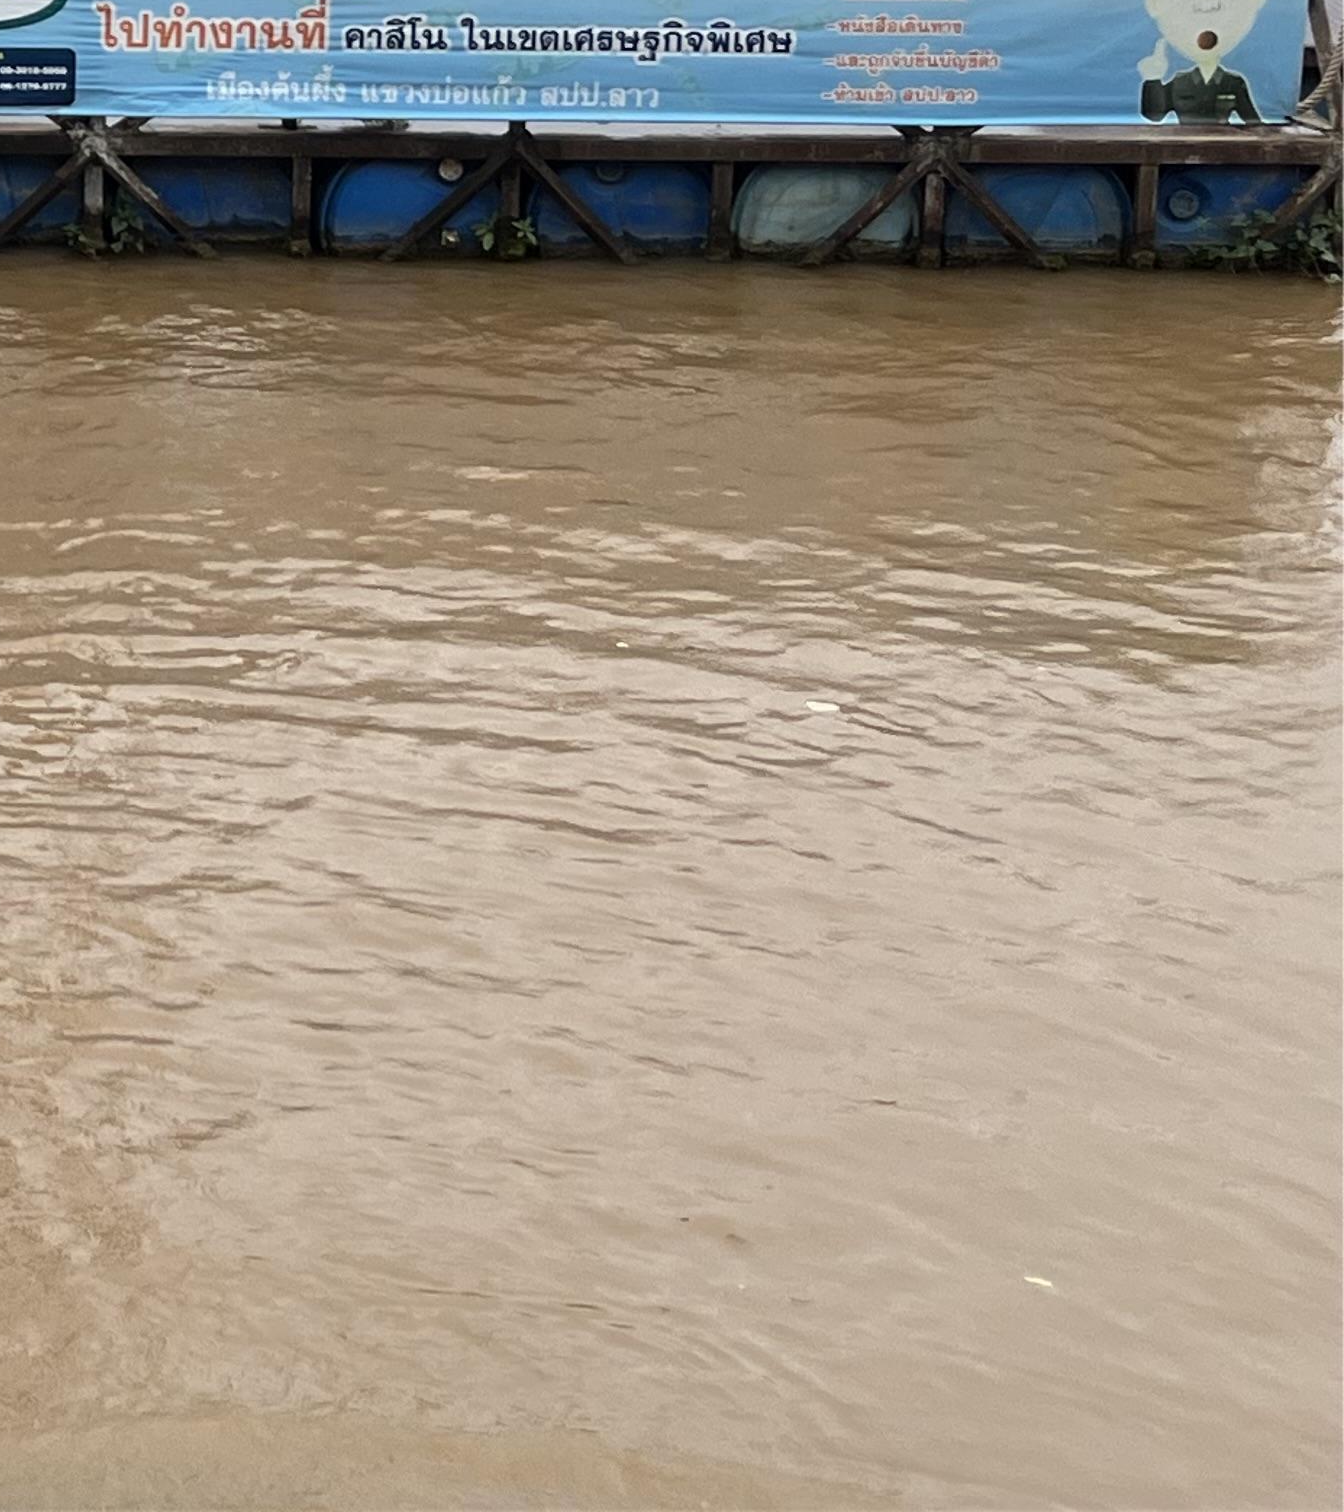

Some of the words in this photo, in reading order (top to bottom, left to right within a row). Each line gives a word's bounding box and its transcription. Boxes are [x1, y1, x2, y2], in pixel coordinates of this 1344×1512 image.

[344, 18, 449, 51] คาสิโน
[461, 18, 793, 62] ในเขตเศรษฐกิจพิเศษ
